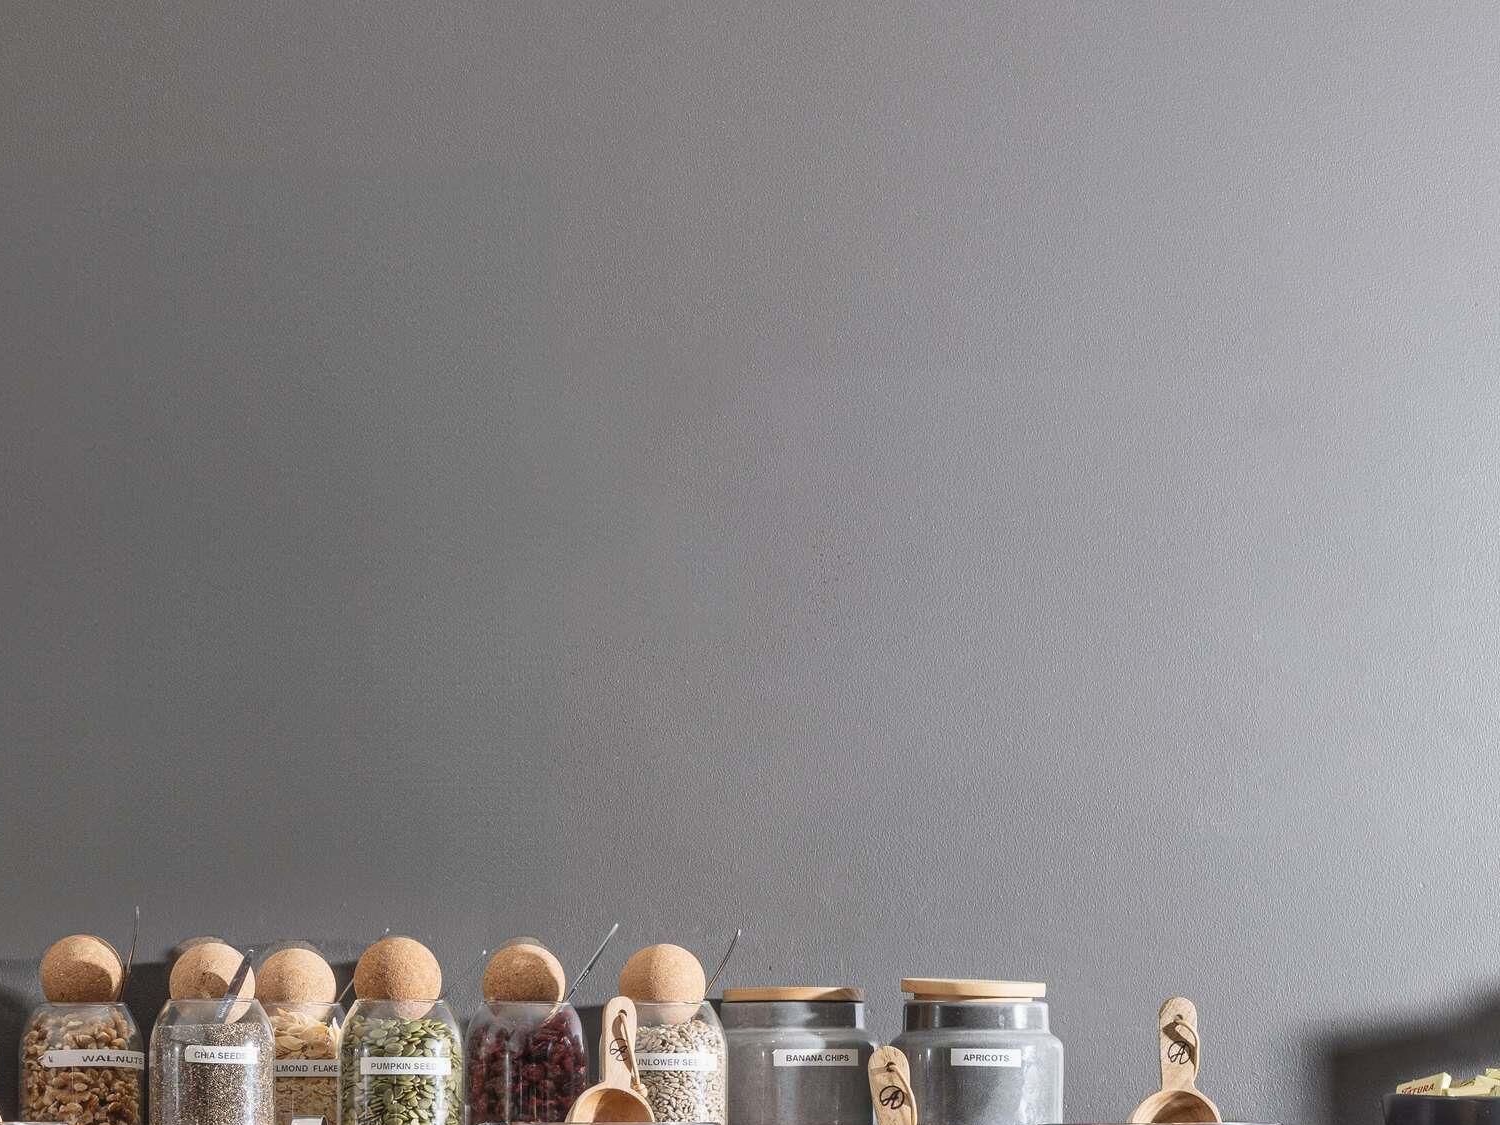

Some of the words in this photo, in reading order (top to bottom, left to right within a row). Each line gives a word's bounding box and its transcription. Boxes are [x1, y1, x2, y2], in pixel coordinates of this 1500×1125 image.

[81, 1054, 144, 1066] WALNUTS
[194, 1051, 216, 1060] CHIA
[785, 1054, 823, 1062] BANANA
[824, 1054, 850, 1062] CHIPS
[962, 1054, 1010, 1062] APRICOTS
[370, 1062, 412, 1071] PUMPKIN
[413, 1062, 438, 1071] SEED
[636, 1058, 680, 1067] UNLOWER
[276, 1064, 309, 1073] LMOND
[313, 1064, 339, 1073] FLAKE
